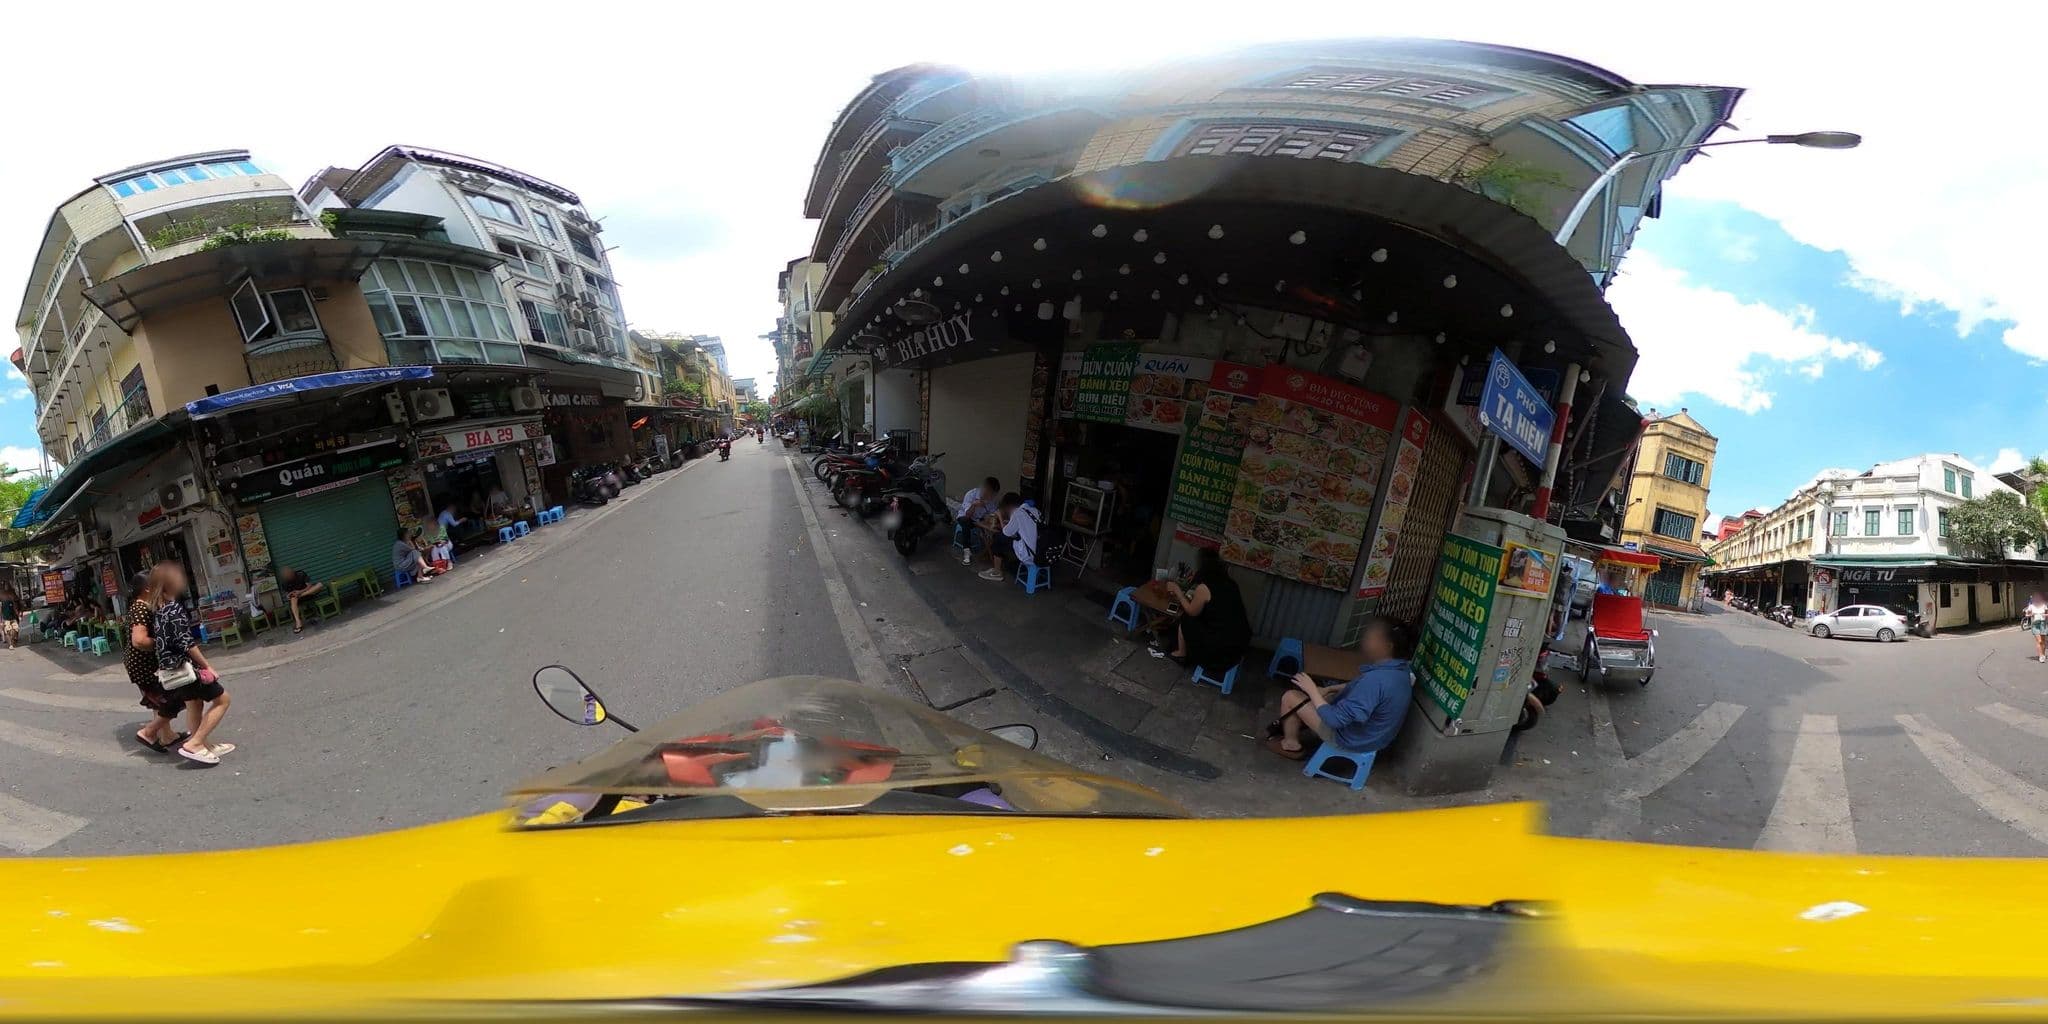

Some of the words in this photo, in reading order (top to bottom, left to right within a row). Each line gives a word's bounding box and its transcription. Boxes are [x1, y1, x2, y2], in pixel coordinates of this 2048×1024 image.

[926, 308, 975, 353] HUY
[276, 382, 295, 391] VISA
[1516, 387, 1538, 415] PHỐ
[1496, 392, 1514, 432] TẠ
[1516, 412, 1546, 455] HIỆN
[465, 431, 494, 449] BIA
[497, 427, 514, 443] 29
[279, 462, 326, 487] Quán
[1460, 571, 1489, 598] RIÊU
[1460, 596, 1486, 624] XÈO
